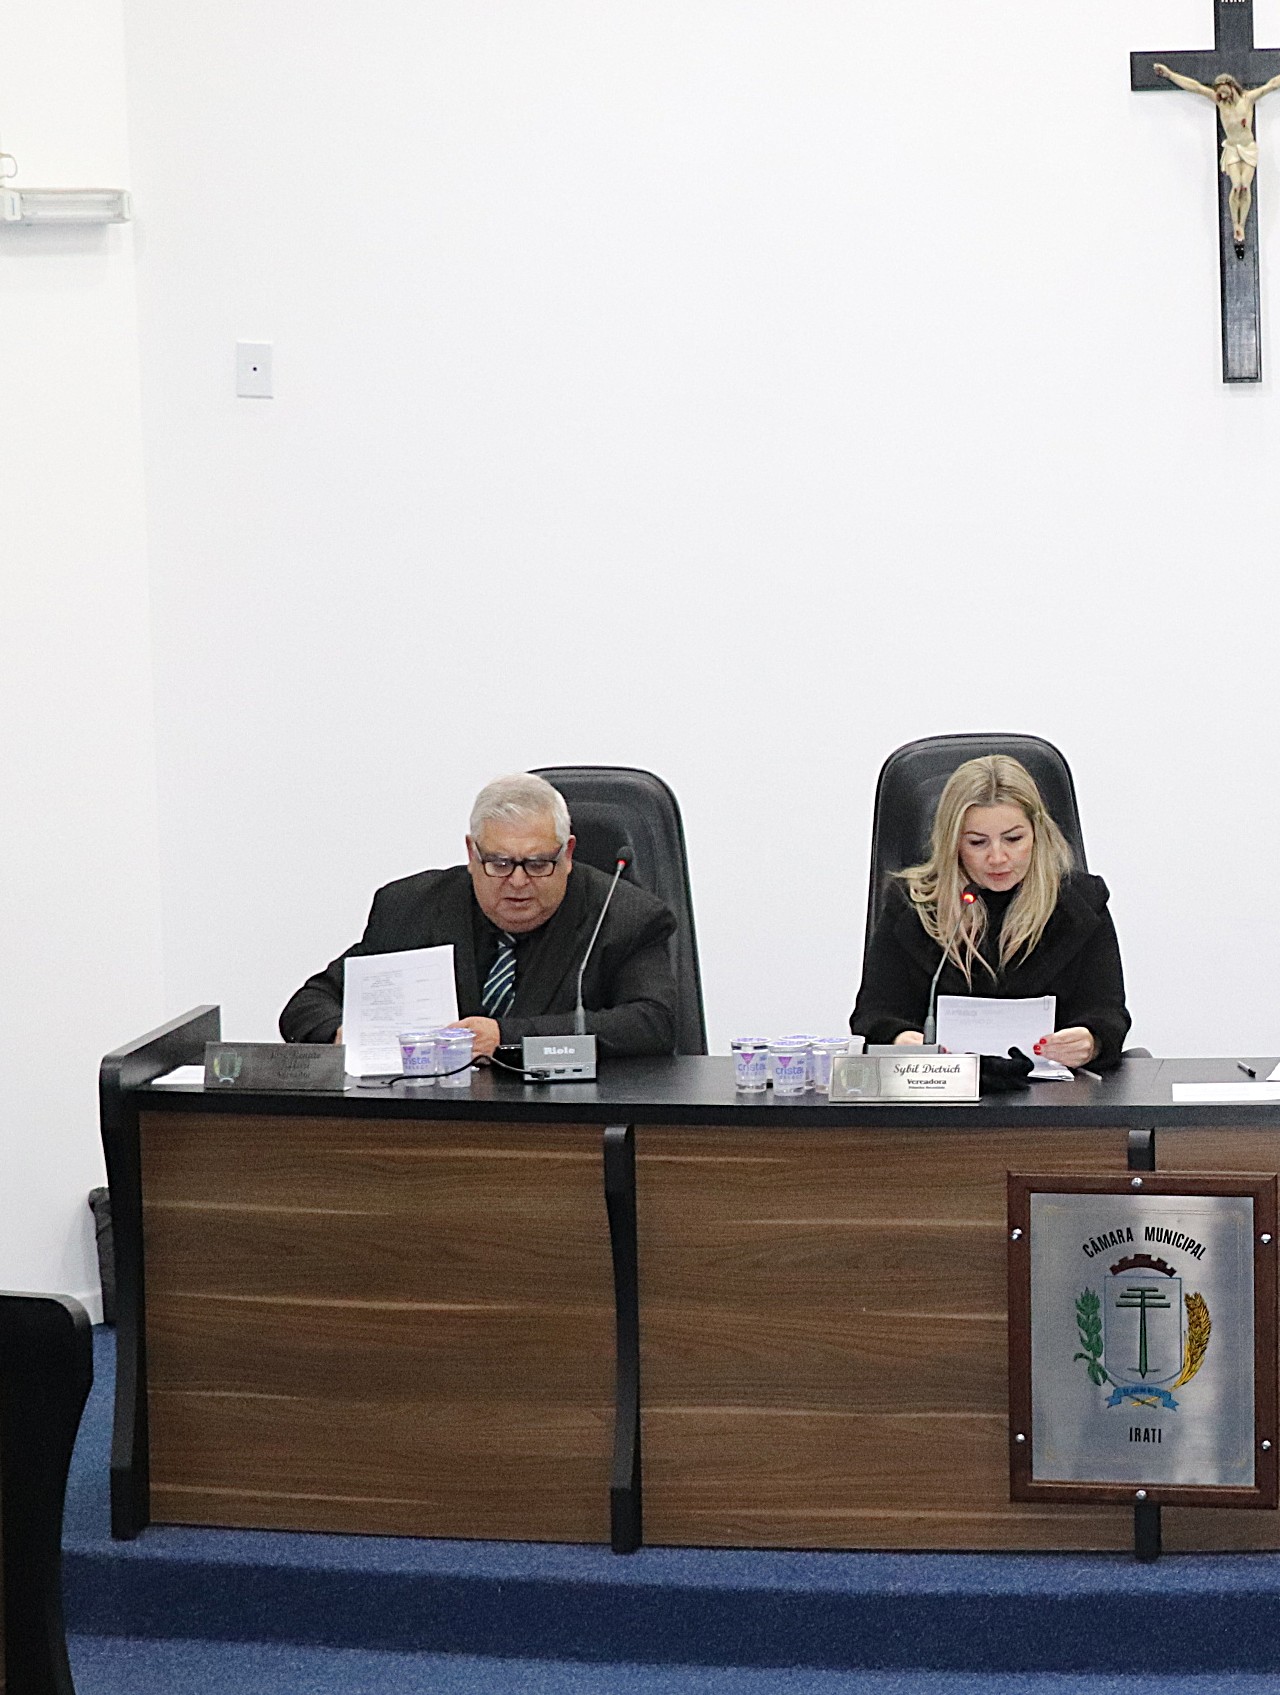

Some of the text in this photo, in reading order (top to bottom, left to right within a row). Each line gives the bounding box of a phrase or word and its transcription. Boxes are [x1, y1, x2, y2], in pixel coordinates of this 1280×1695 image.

[543, 1046, 576, 1055] Riole
[893, 1063, 961, 1077] Sybil Dietrich
[1082, 1226, 1206, 1261] CÂMARA MUNICIPAL
[1129, 1427, 1162, 1443] IRATI
